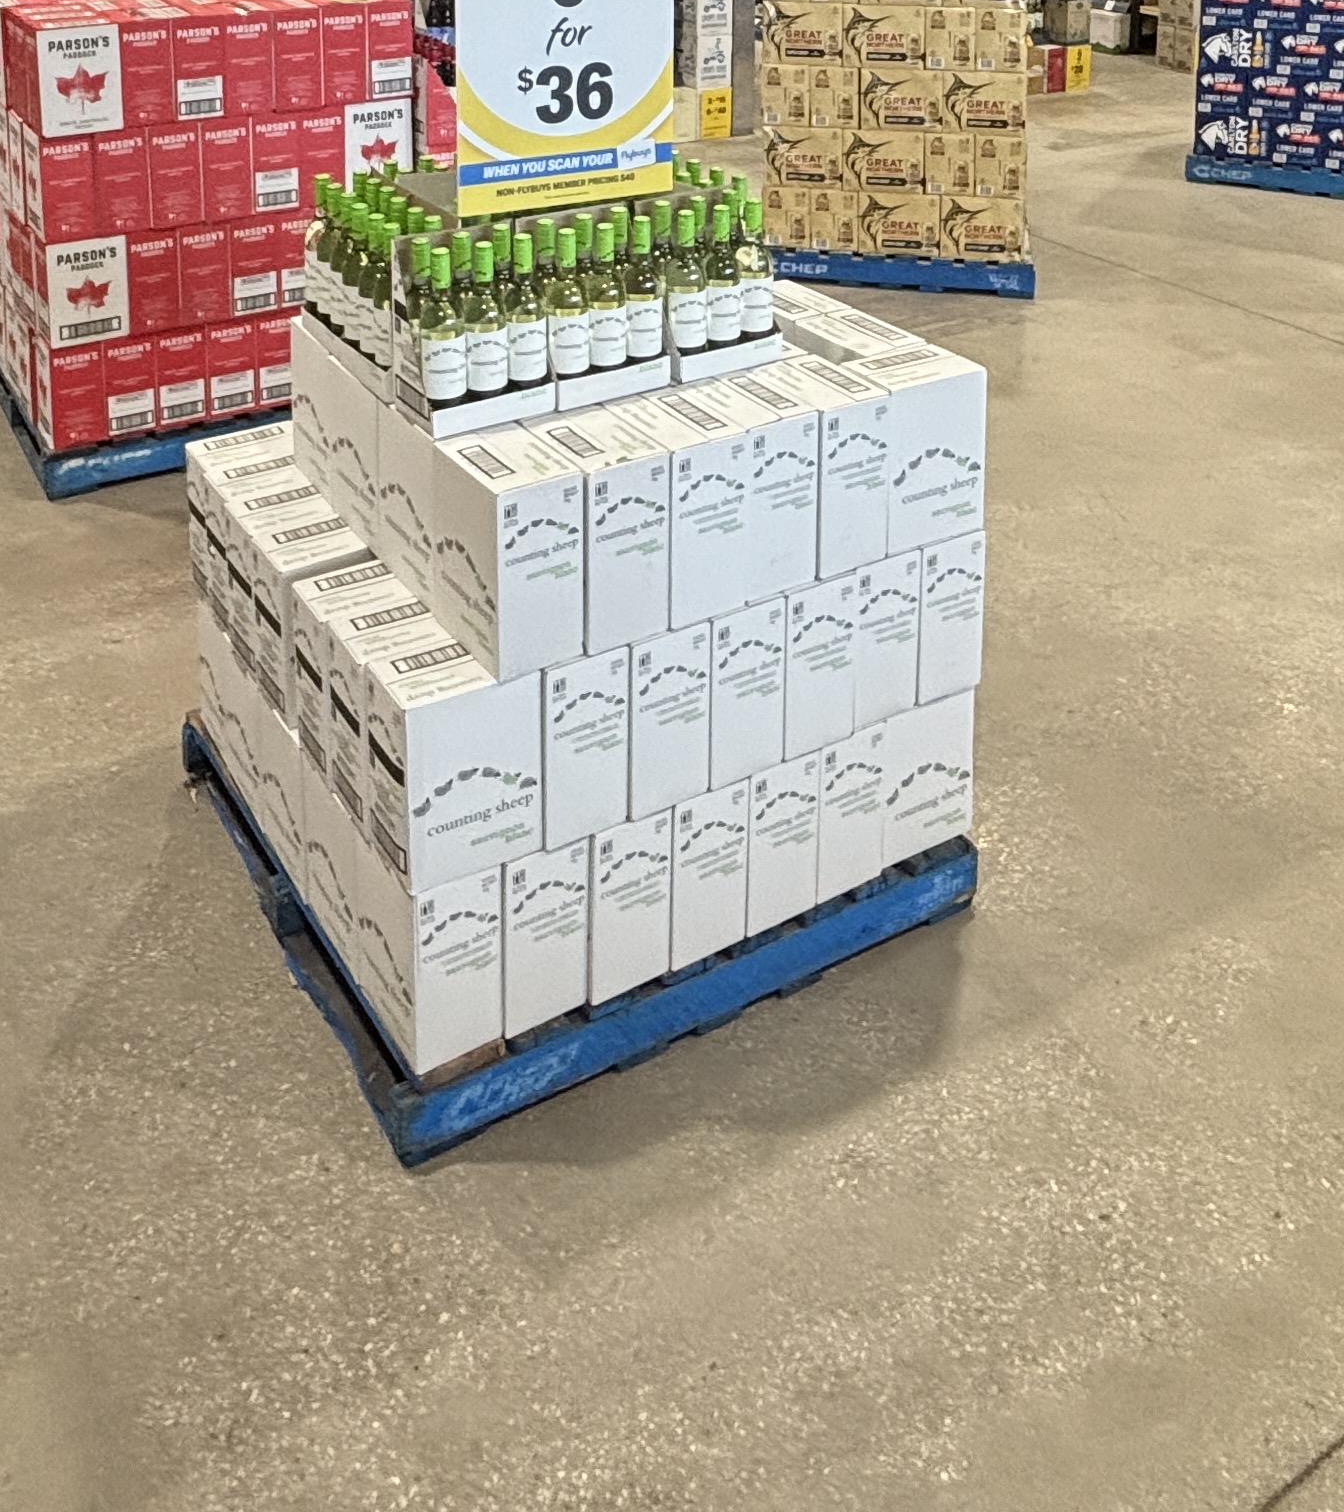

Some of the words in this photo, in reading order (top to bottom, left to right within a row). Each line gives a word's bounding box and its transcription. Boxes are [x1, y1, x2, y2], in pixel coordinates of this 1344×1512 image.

[324, 15, 363, 26] PARSON'S
[370, 11, 408, 22] PARSON'S
[226, 22, 268, 34] PARSON'S
[276, 18, 317, 31] PARSON'S
[123, 29, 167, 42] PARSON'S
[176, 26, 220, 39] PARSON'S
[546, 17, 593, 56] for
[785, 29, 822, 40] GREAT
[866, 33, 904, 43] GREAT
[48, 36, 110, 52] PARSON'S
[1231, 28, 1240, 68] CARLTON
[1238, 29, 1253, 68] DRY
[517, 61, 614, 124] $36
[884, 97, 922, 107] GREAT
[966, 99, 1005, 110] GREAT
[353, 108, 404, 124] PARSON'S
[205, 127, 247, 140] PARSON'S
[256, 120, 297, 134] PARSON'S
[99, 137, 143, 152] PARSON'S
[152, 132, 195, 145] PARSON'S
[43, 142, 89, 156] PARSON'S
[483, 164, 520, 179] WHEN
[521, 160, 546, 175] YOU
[547, 156, 581, 171] SCAN
[582, 152, 614, 168] YOUR
[786, 154, 822, 164] GREAT
[496, 182, 551, 197] NON-FLYBUYS
[552, 179, 586, 191] MEMBER
[587, 175, 619, 187] PRICING
[620, 172, 635, 182] $40
[56, 247, 117, 266] PARSON'S
[780, 261, 828, 274] CHEP
[902, 485, 947, 504] counting
[950, 477, 979, 491] sheep
[427, 807, 492, 837] counting
[495, 793, 534, 816] sheep
